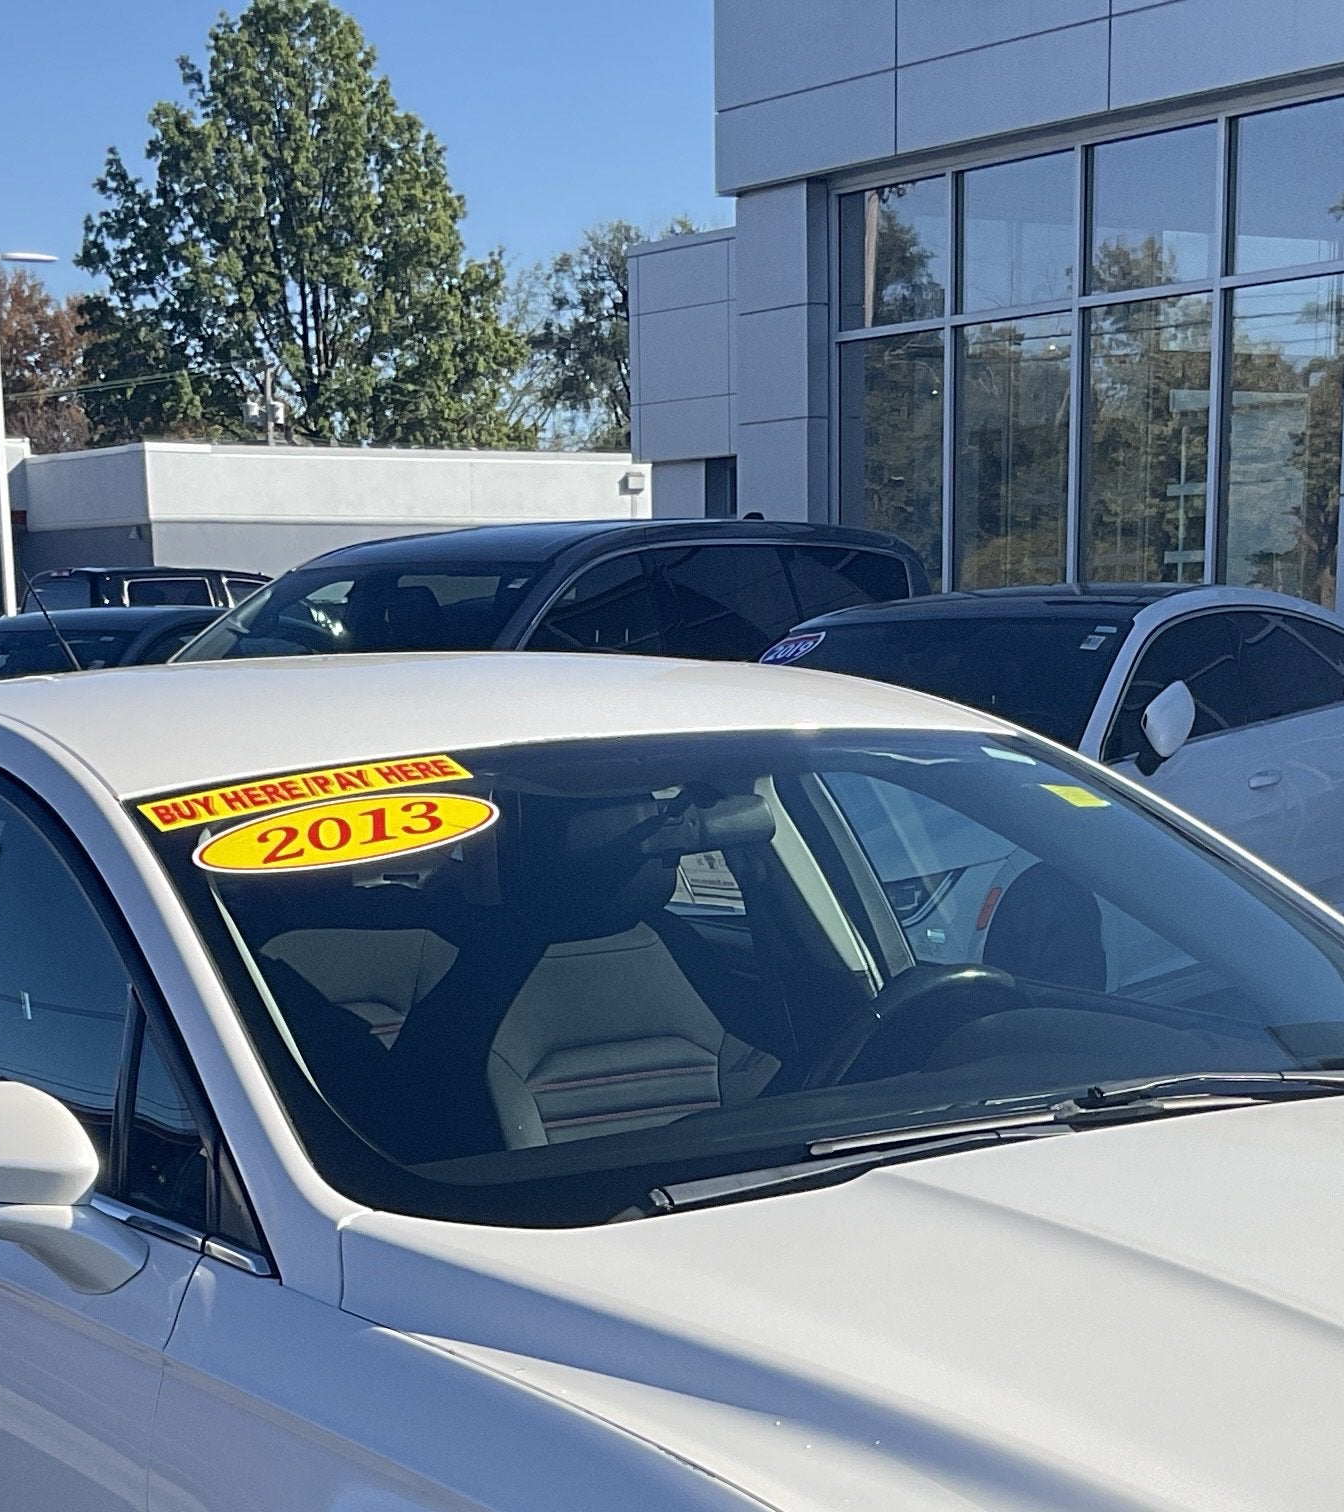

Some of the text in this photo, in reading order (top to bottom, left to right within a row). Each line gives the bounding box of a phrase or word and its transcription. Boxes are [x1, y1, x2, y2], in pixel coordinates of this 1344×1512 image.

[763, 641, 814, 661] 2019
[151, 796, 216, 825] BUY
[374, 759, 461, 784] HERE
[257, 801, 443, 864] 2013
